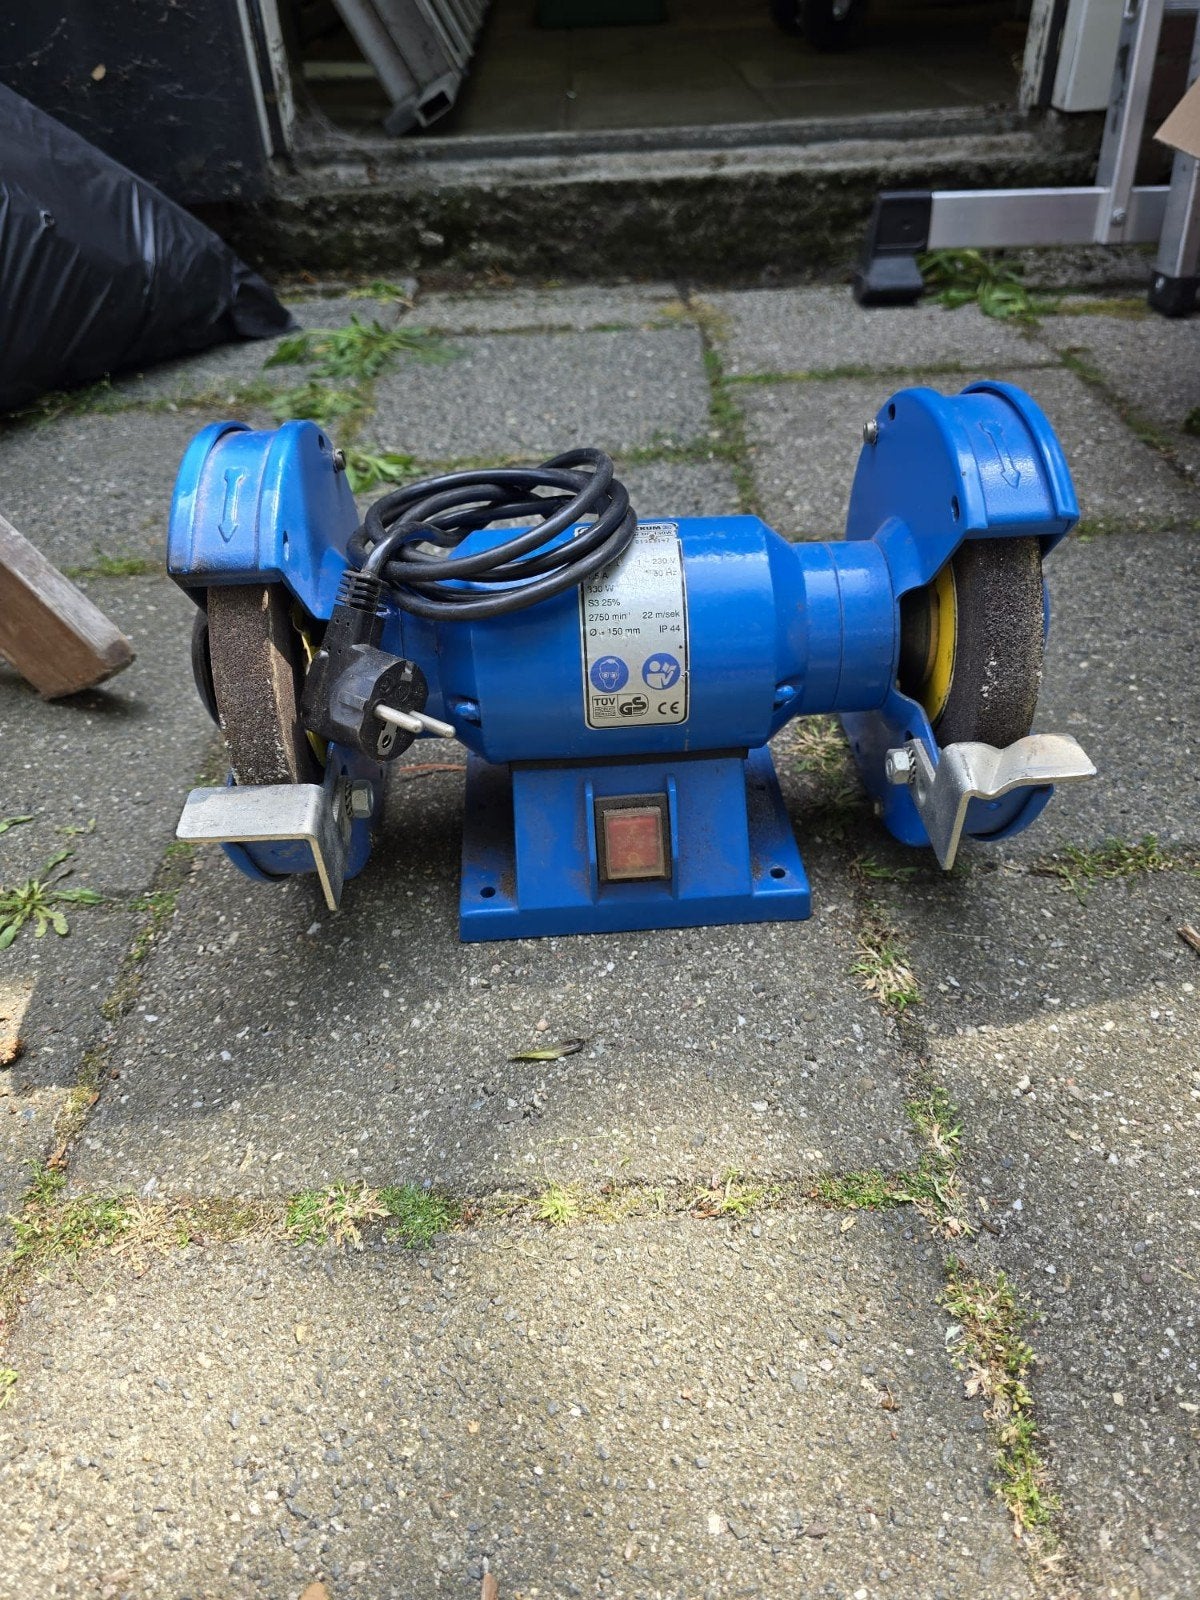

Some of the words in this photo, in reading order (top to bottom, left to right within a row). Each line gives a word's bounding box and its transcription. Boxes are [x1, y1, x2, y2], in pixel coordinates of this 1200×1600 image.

[652, 557, 668, 565] 230
[601, 599, 621, 607] 25%
[588, 613, 610, 622] 2750
[642, 612, 653, 620] 22
[655, 610, 680, 619] m/sek
[607, 627, 623, 636] 150
[659, 625, 668, 633] IP
[670, 624, 681, 632] 44
[619, 696, 647, 716] GS
[657, 701, 680, 715] CE
